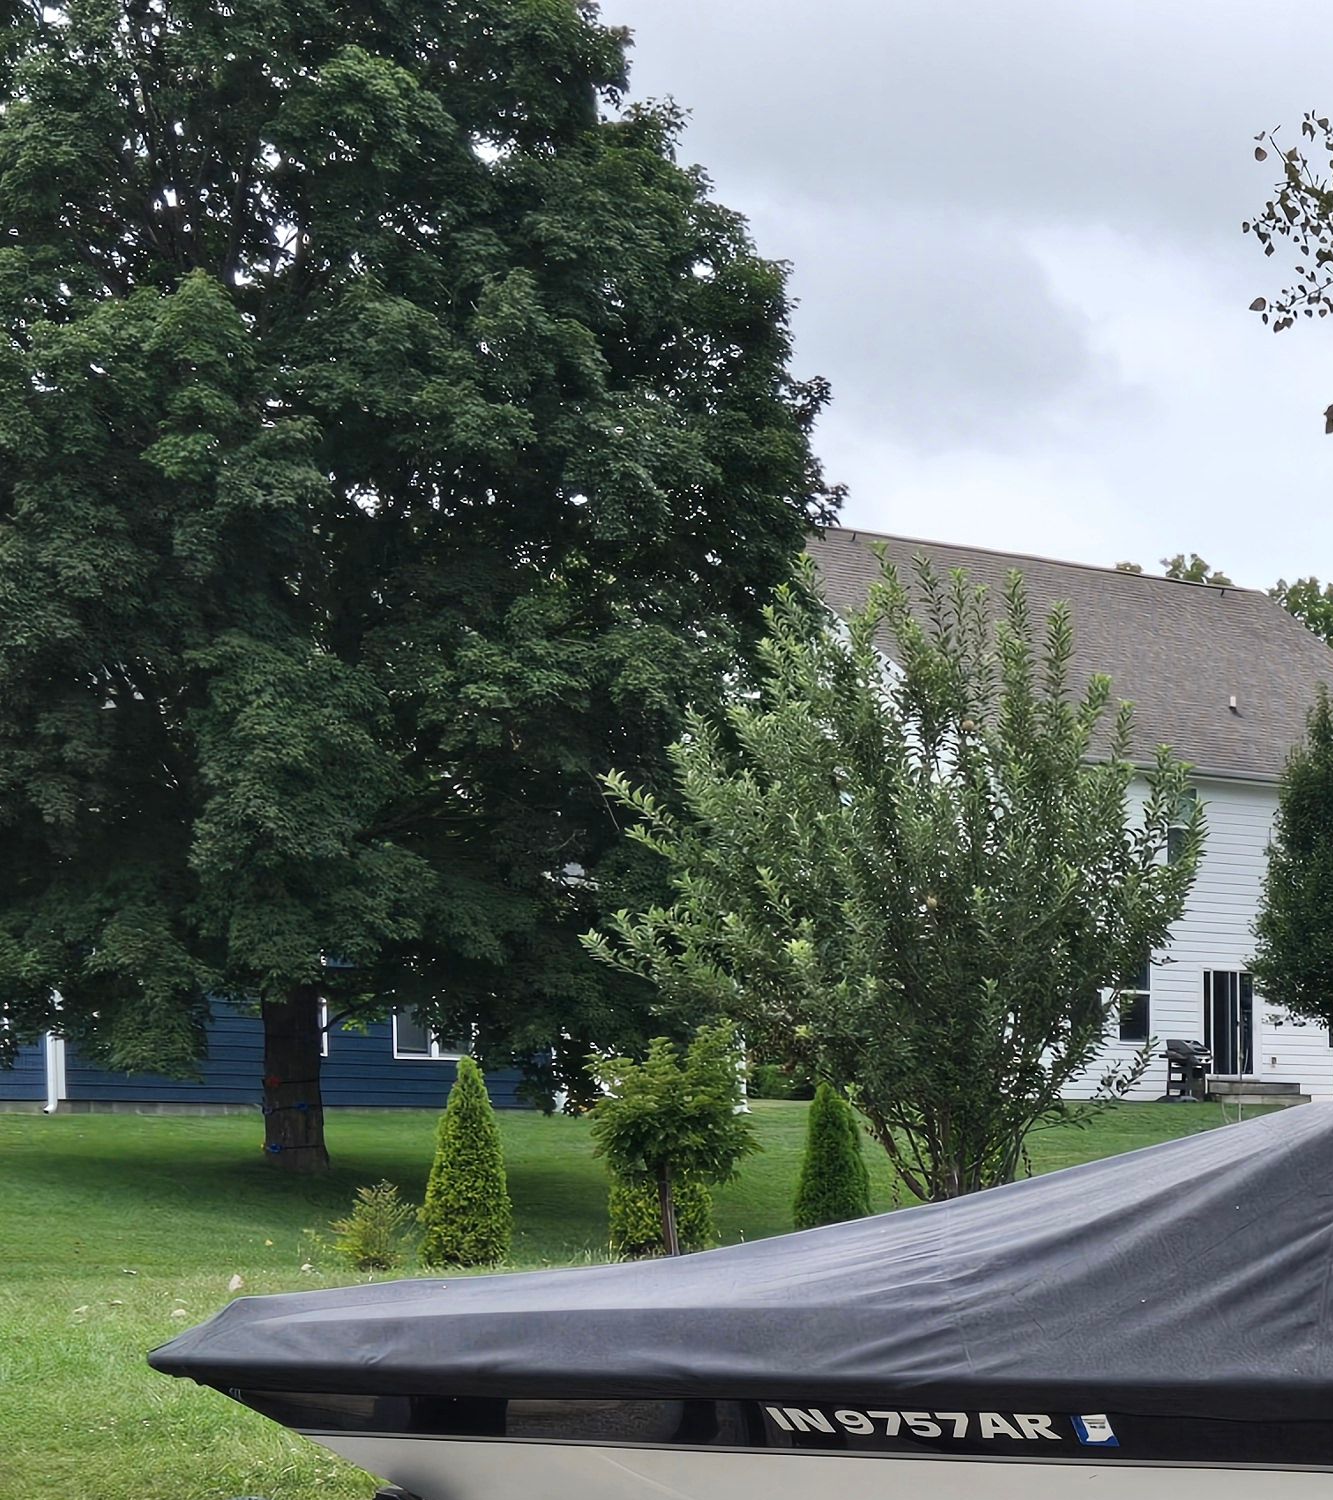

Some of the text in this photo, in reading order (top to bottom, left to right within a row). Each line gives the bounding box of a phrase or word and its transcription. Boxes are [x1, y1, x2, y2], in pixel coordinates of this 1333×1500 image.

[765, 1406, 837, 1434] IN
[834, 1409, 970, 1438] 9757
[979, 1412, 1063, 1441] AR
